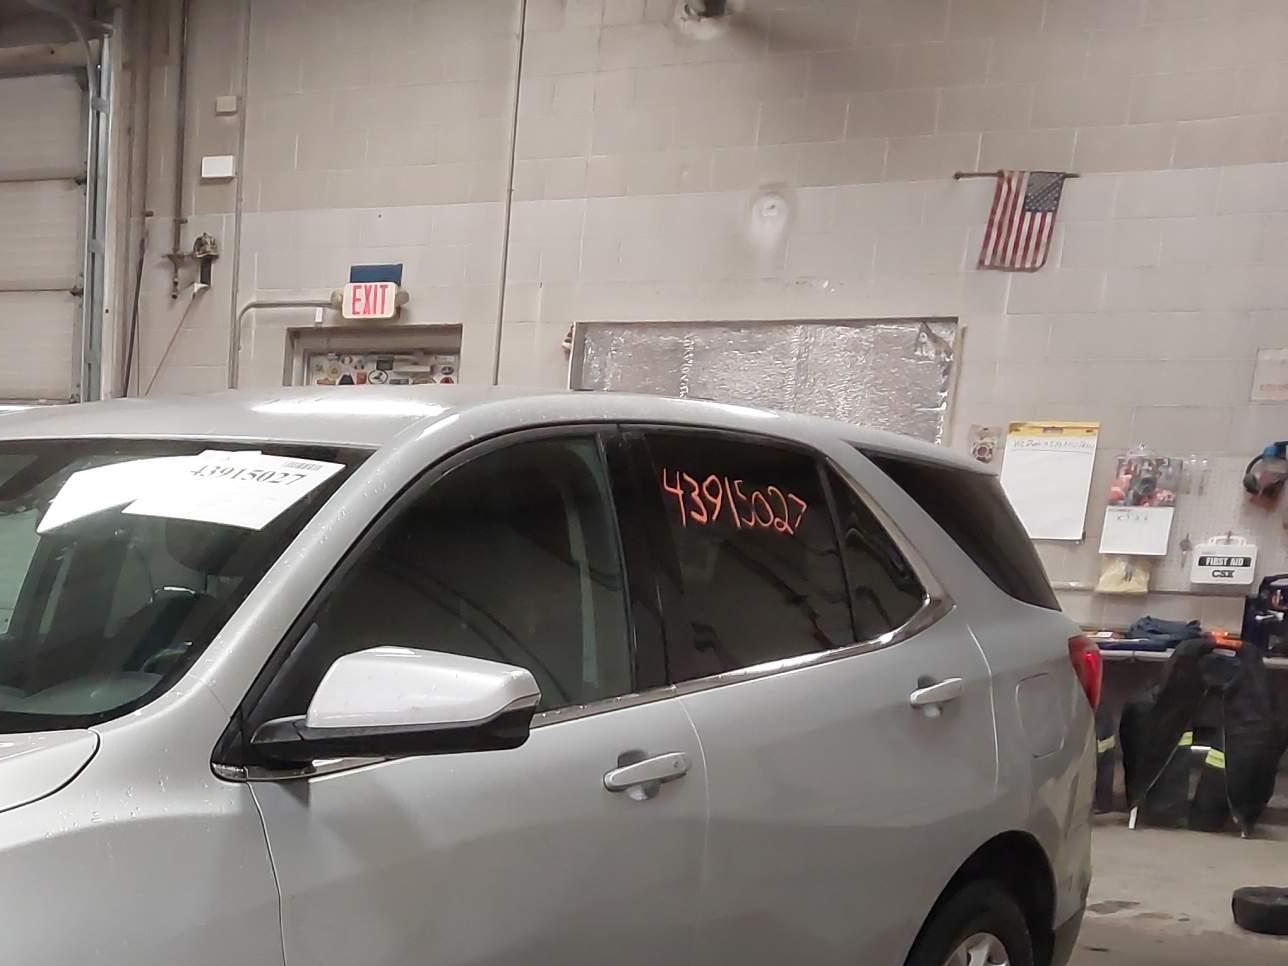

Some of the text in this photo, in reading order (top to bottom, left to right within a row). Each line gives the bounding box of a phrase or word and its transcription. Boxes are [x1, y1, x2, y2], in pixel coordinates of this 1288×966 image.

[351, 284, 389, 315] EXIT
[190, 464, 307, 486] 43915027
[663, 468, 808, 535] 43915027
